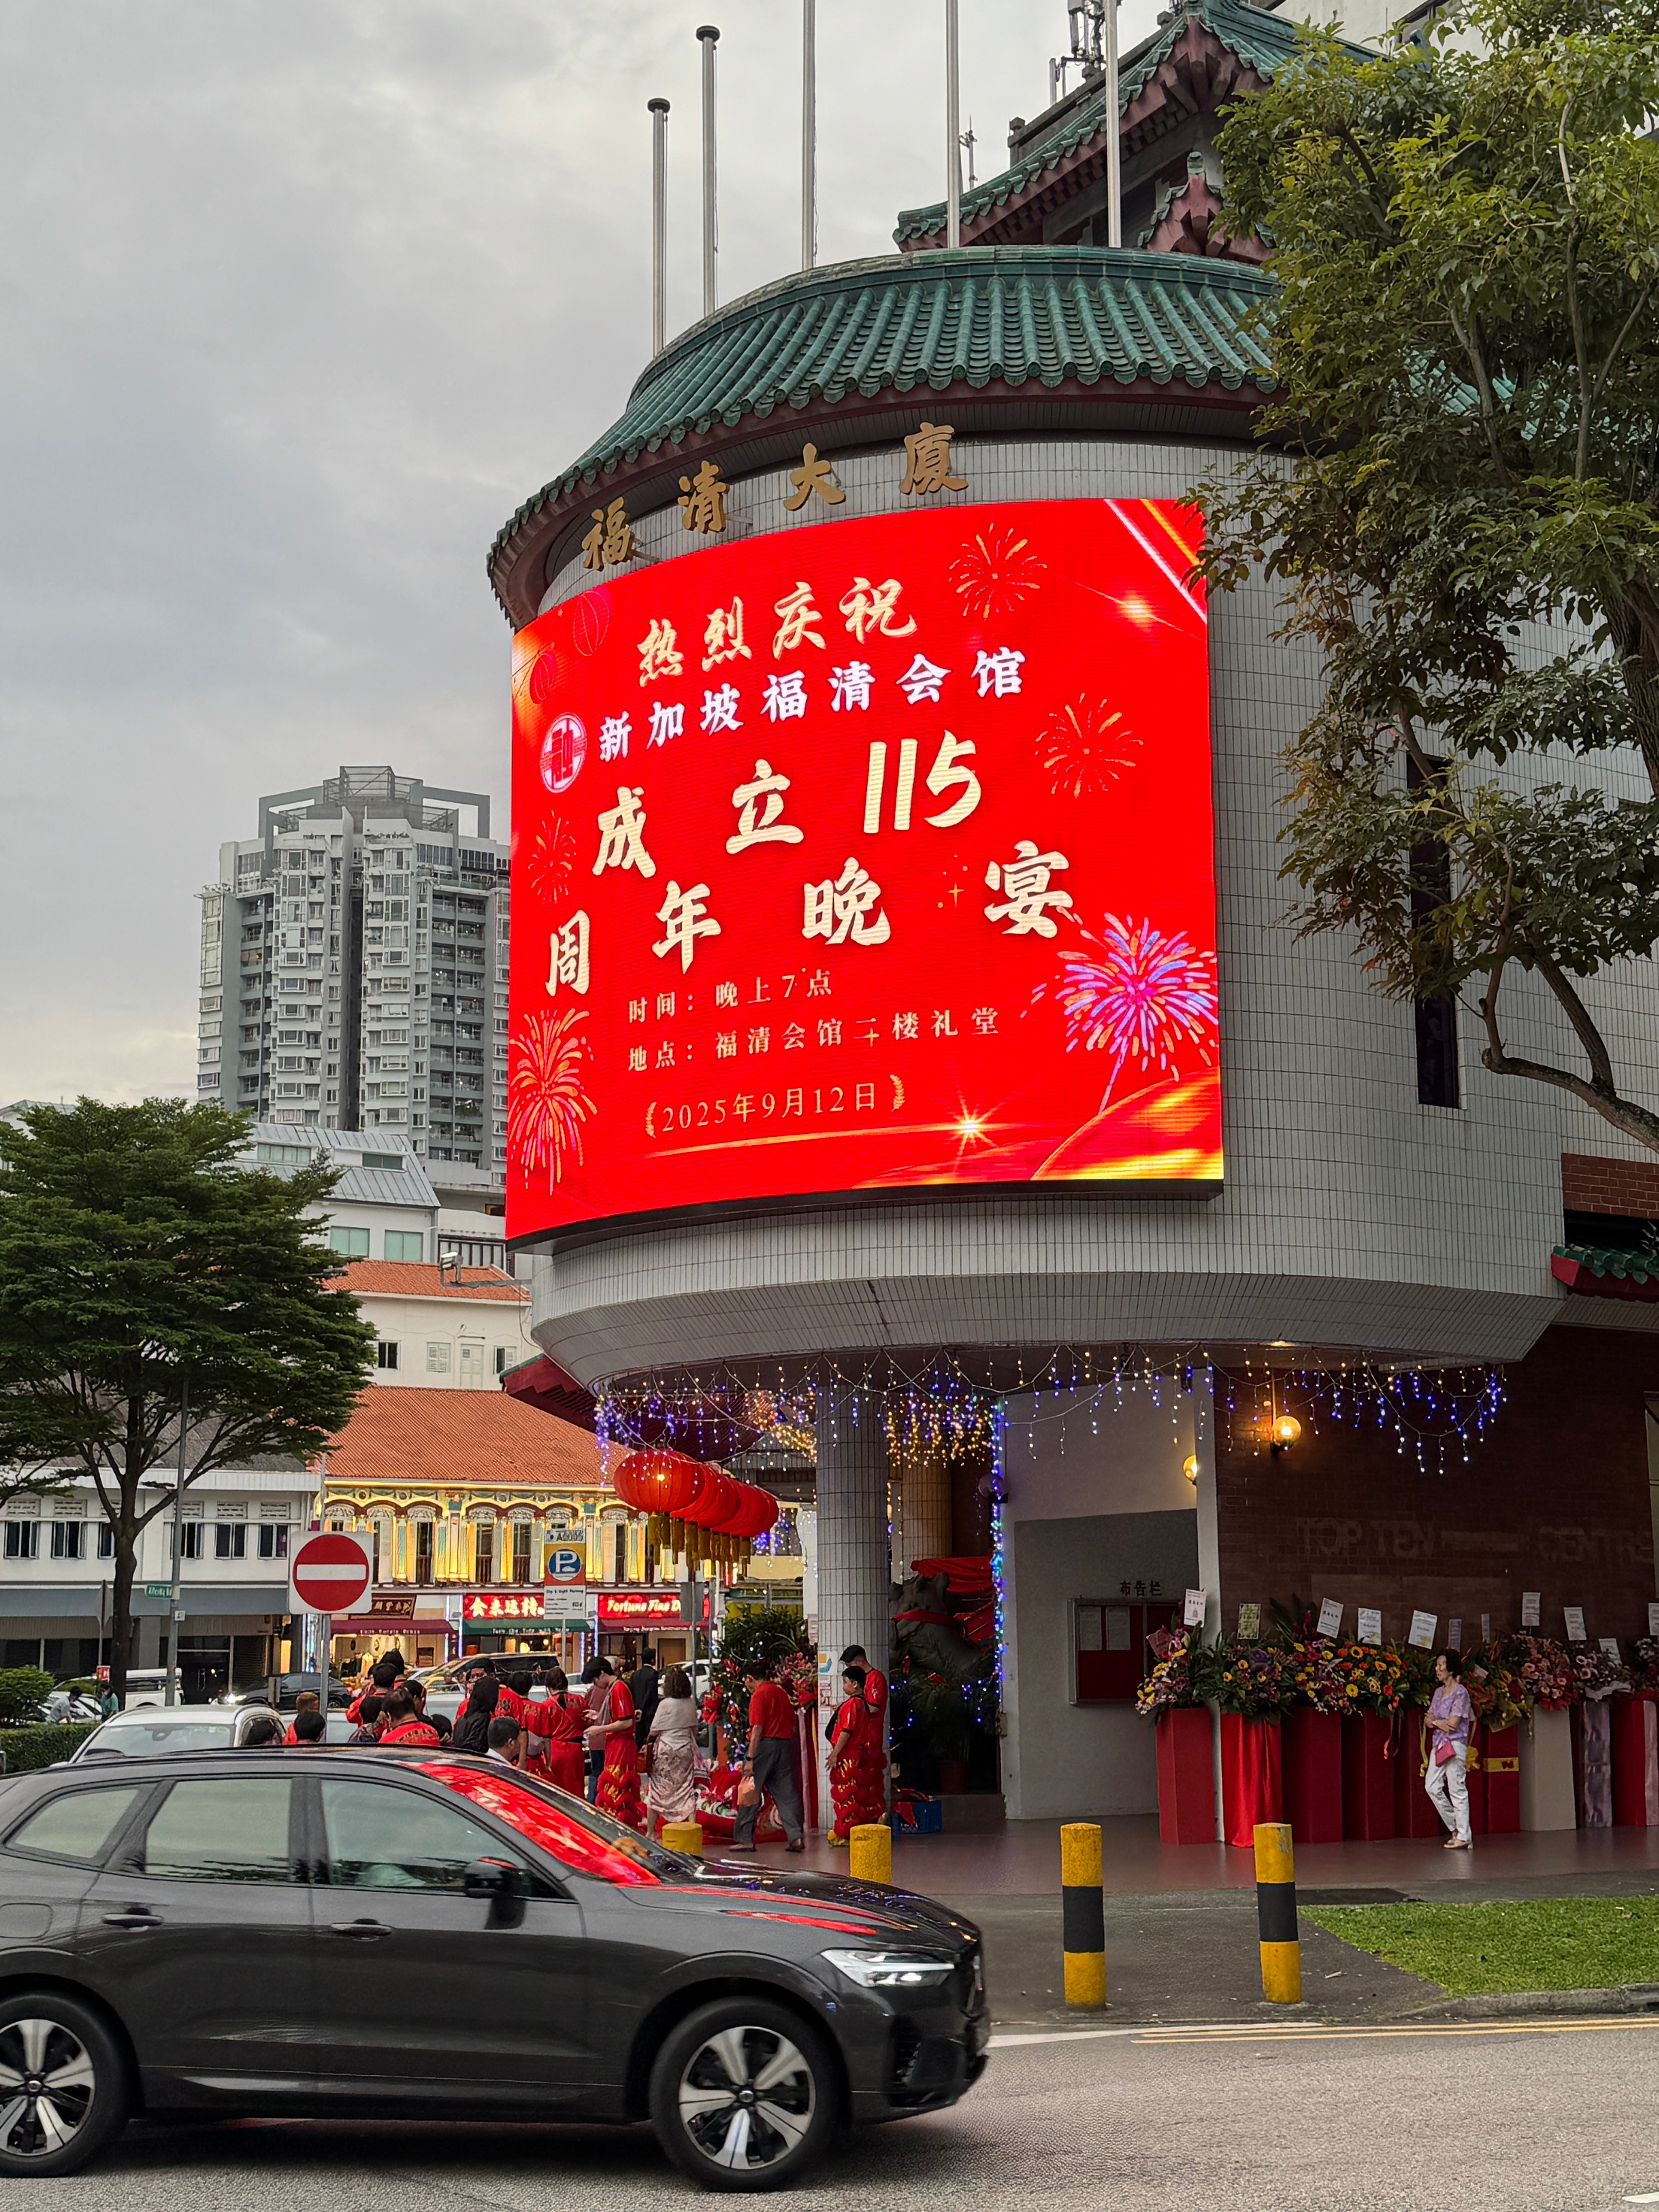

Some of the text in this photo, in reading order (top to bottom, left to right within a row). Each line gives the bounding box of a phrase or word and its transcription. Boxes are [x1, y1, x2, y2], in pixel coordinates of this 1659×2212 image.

[637, 577, 917, 688] 热烈庆祝
[598, 646, 1026, 762] 新加坡福清会馆
[545, 840, 1074, 997] 周年晚宴
[662, 1082, 874, 1132] 2025年9月12日
[606, 1599, 647, 1612] Fortune
[648, 1599, 670, 1612] Fine
[1120, 1580, 1162, 1597] 布告栏
